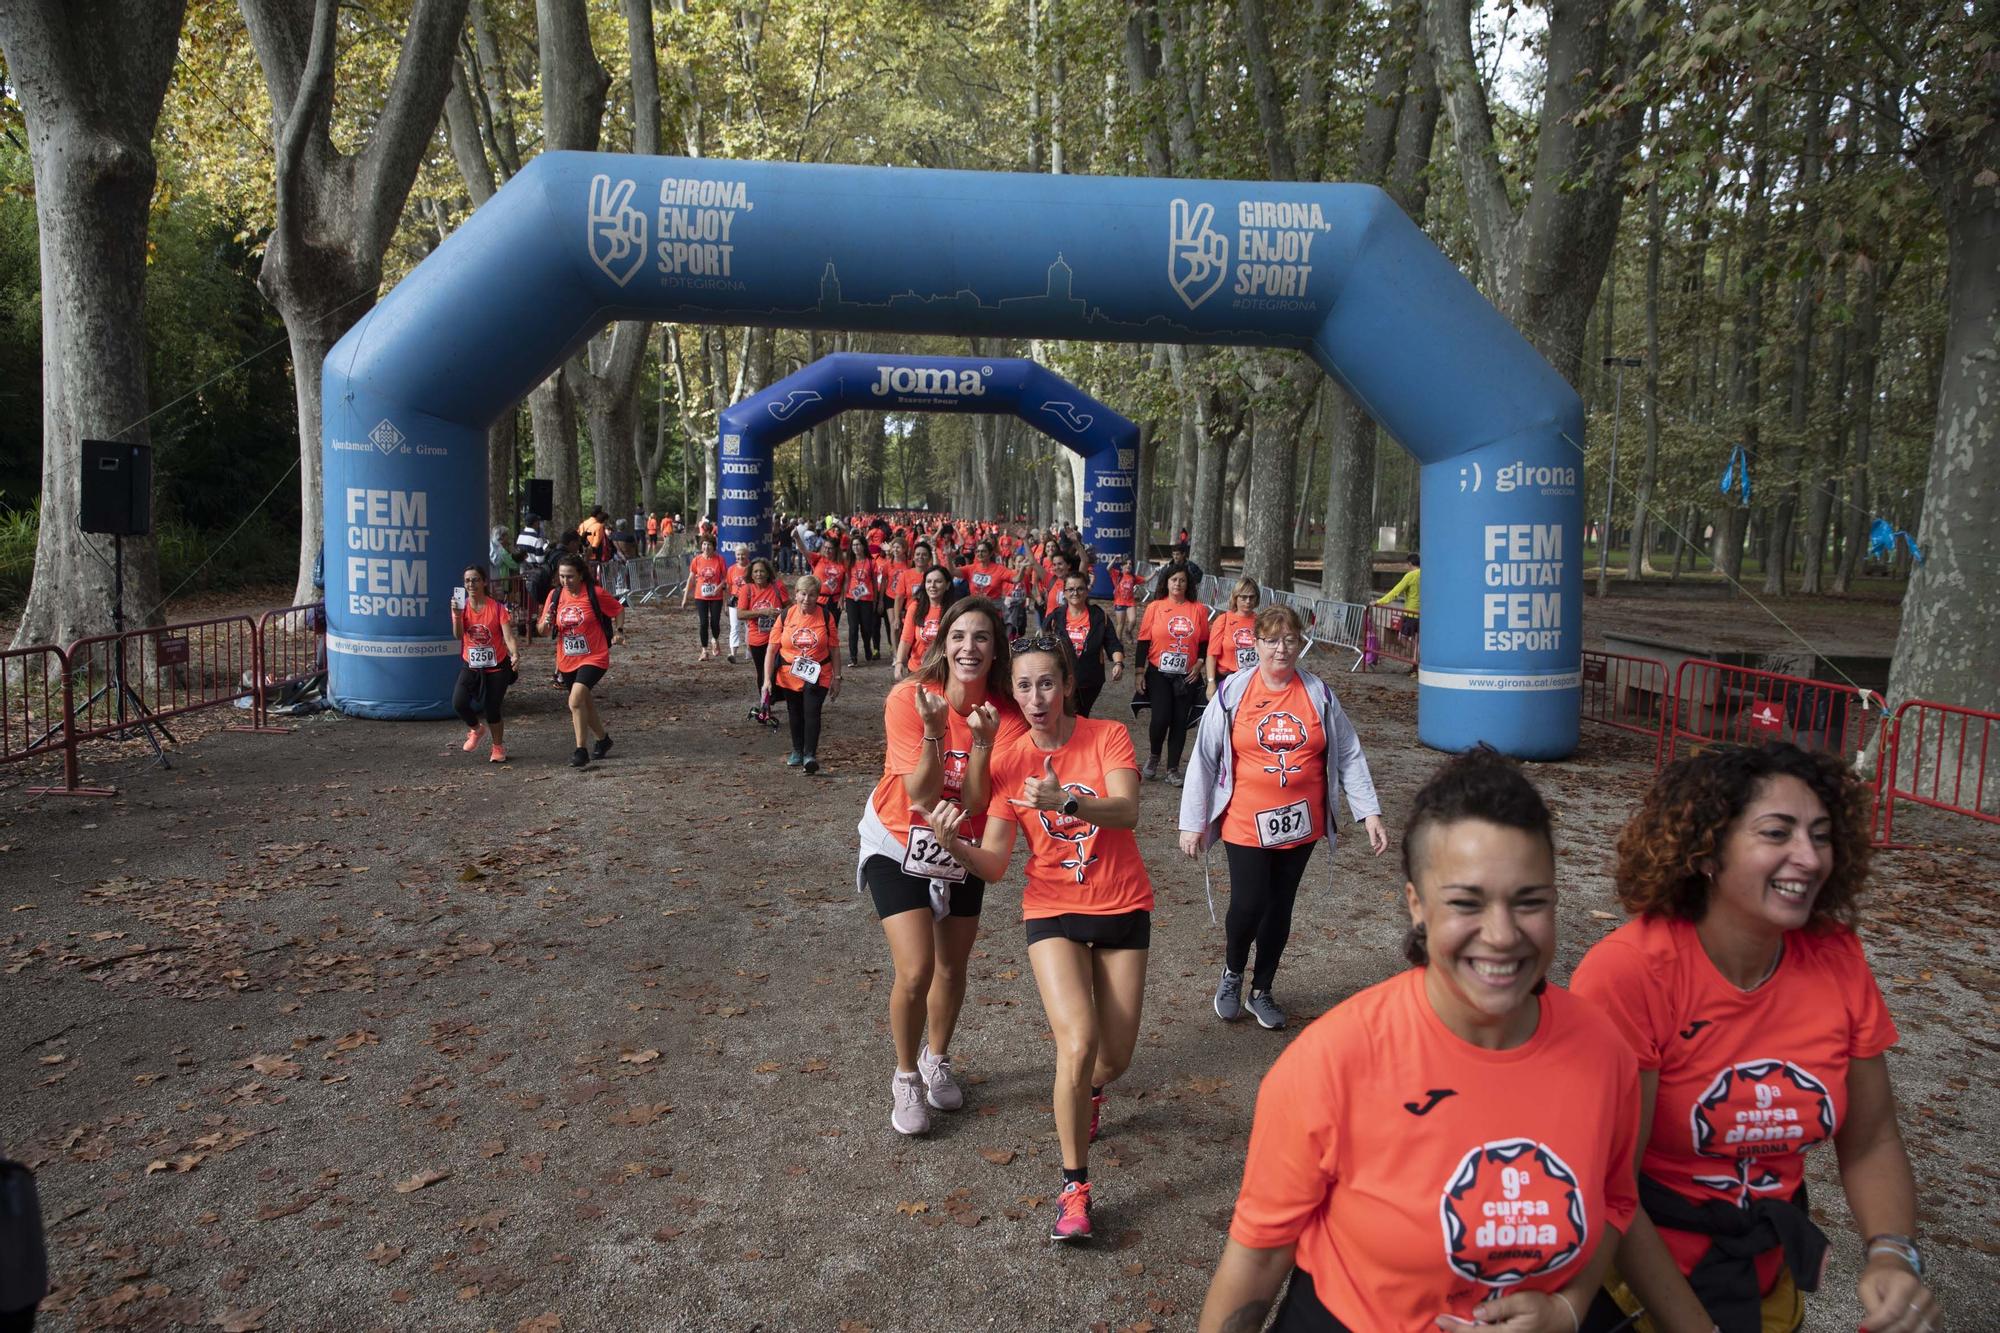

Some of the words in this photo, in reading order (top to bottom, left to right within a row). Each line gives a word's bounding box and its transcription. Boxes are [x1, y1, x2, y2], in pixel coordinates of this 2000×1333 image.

[660, 178, 754, 212] GIRONA,
[658, 207, 735, 242] ENJOY
[1238, 201, 1332, 233] GIRONA,
[1238, 229, 1314, 263] ENJOY
[657, 241, 734, 276] SPORT
[661, 277, 747, 292] #DTEGIRONA
[1234, 264, 1312, 297] SPORT
[1233, 299, 1318, 312] #DTEGIRONA
[331, 439, 374, 452] Ajuntament
[400, 444, 412, 454] de
[416, 445, 448, 456] Girona
[1496, 461, 1575, 492] girona
[347, 488, 428, 527] FEM
[347, 527, 430, 553] CIUTAT
[1484, 524, 1562, 561] FEM
[347, 556, 428, 595] FEM
[1485, 563, 1563, 586] CIUTAT
[349, 594, 429, 617] ESPORT
[1484, 593, 1562, 629] FEM
[565, 640, 585, 650] 5948
[1484, 631, 1562, 651] ESPORT
[470, 651, 493, 662] 5250
[1162, 656, 1186, 668] 5438
[797, 663, 815, 676] 519
[1268, 733, 1296, 741] dona
[1269, 811, 1302, 836] 987
[1735, 1107, 1798, 1123] cursa
[1725, 1124, 1804, 1144] dona
[1737, 1142, 1789, 1156] GIRONA
[1482, 1200, 1549, 1217] cursa
[1504, 1216, 1516, 1225] DE
[1517, 1216, 1529, 1225] LA
[1475, 1220, 1558, 1248] dona
[1487, 1250, 1543, 1262] GIRONA
